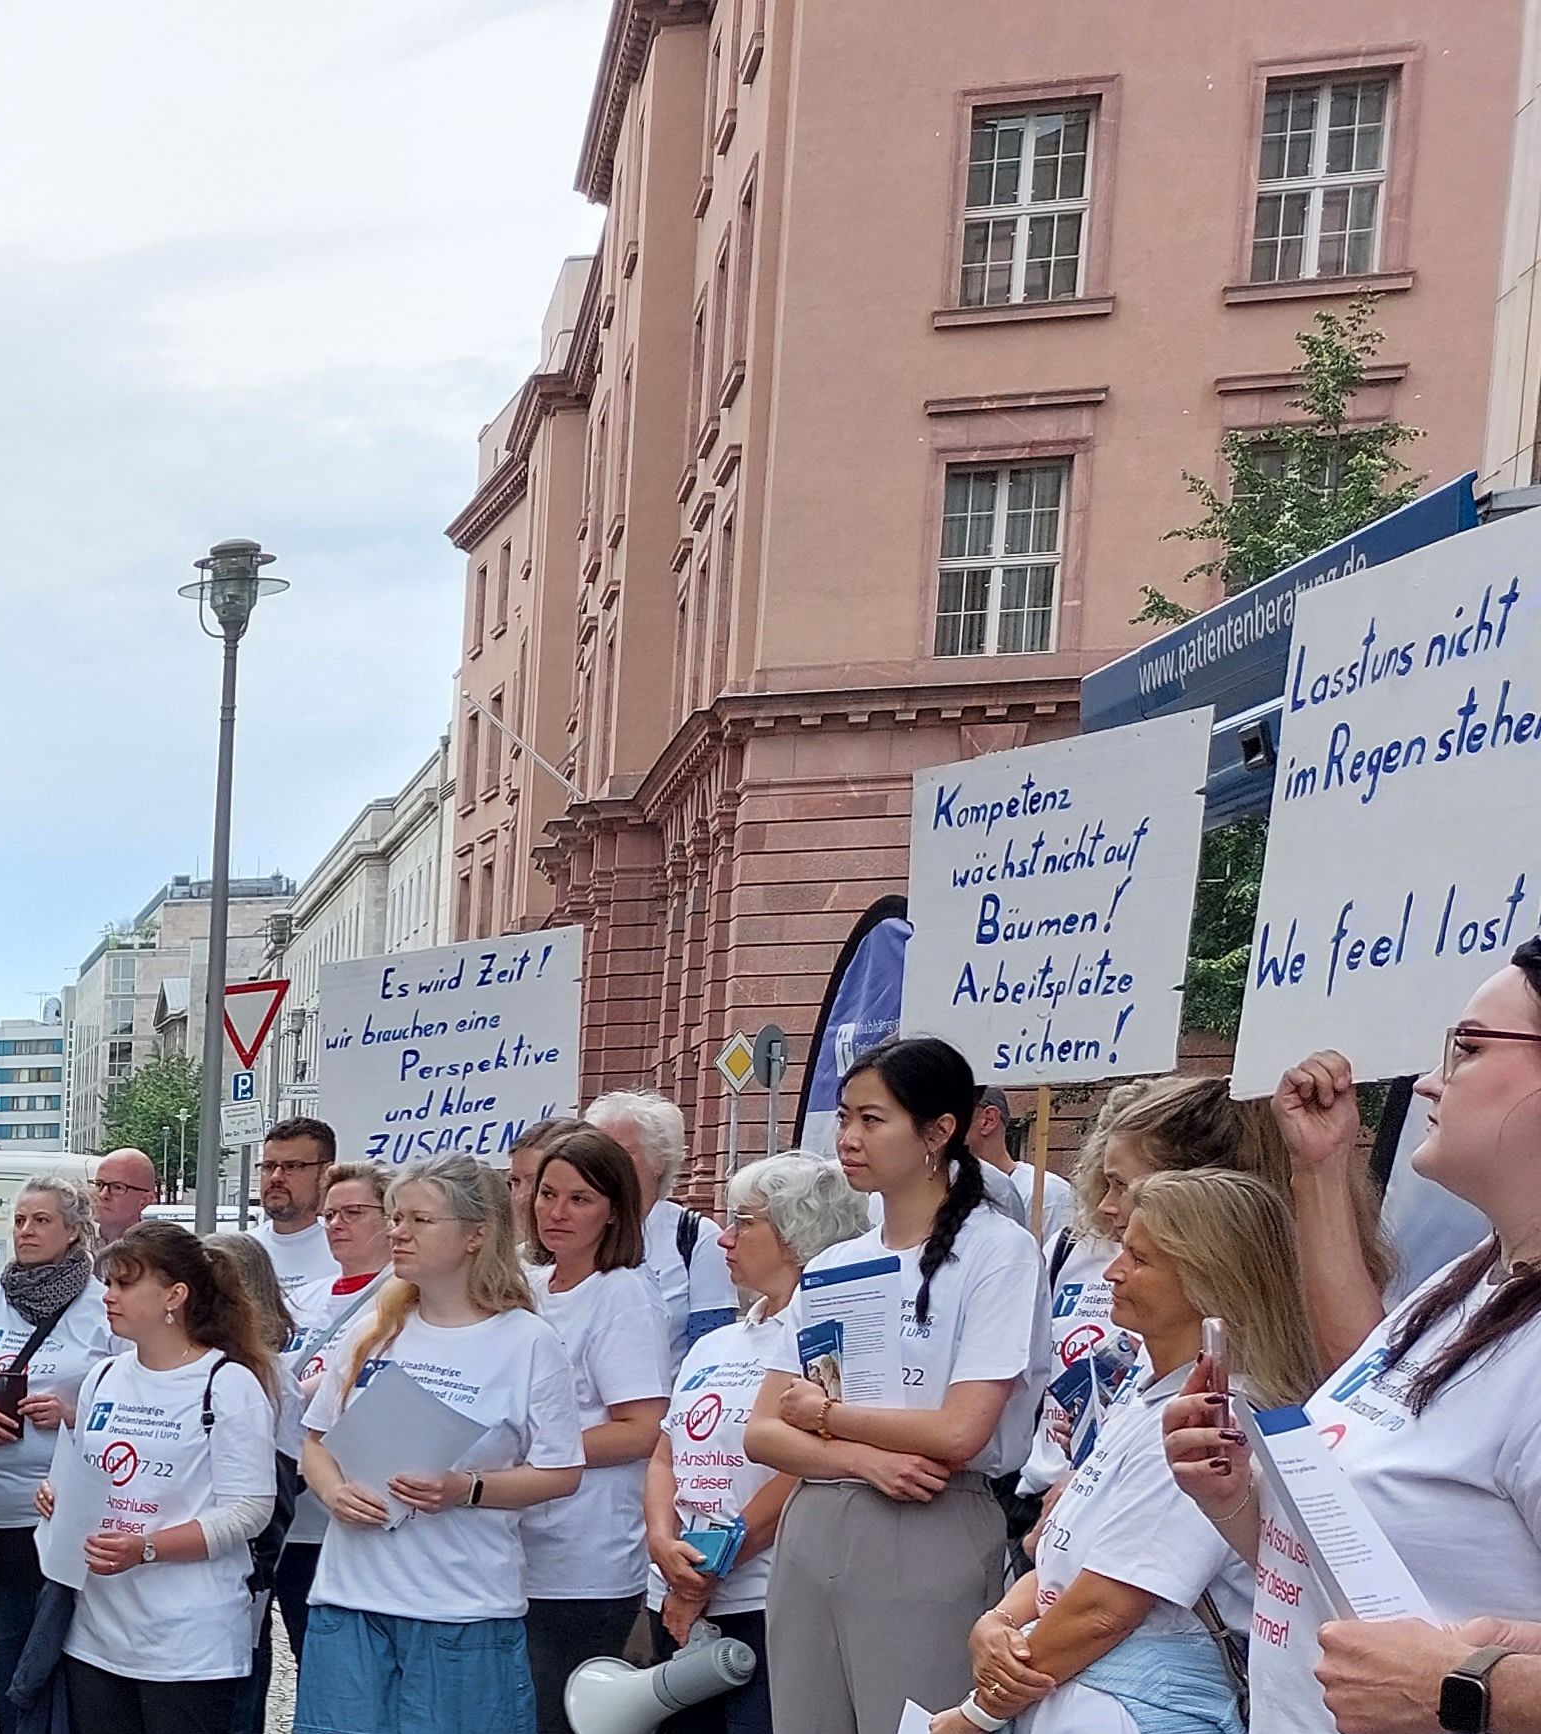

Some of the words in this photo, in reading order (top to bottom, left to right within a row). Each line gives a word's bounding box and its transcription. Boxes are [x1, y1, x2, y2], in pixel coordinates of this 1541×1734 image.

[1138, 544, 1367, 695] www.patientenberade
[1425, 575, 1520, 668] nicht
[1284, 757, 1317, 801] im
[1323, 722, 1427, 804] Regen
[933, 772, 1072, 836] Kompetenz
[952, 831, 1045, 888] wächst
[1042, 819, 1105, 874] nicht
[1103, 816, 1150, 871] auf
[975, 875, 1132, 945] Bäumen!
[1256, 917, 1306, 990] We
[1327, 891, 1414, 997] feel
[381, 967, 410, 1000] Es
[418, 958, 464, 994] wird
[952, 949, 1133, 1009] Arbeitsplätze
[325, 1027, 353, 1050] wir
[361, 1009, 447, 1046] brauchen
[455, 1010, 502, 1033] eine
[993, 1003, 1134, 1070] sichern!
[400, 1034, 560, 1082] Perspektive
[384, 1090, 434, 1122] und
[440, 1085, 497, 1116] klare
[365, 1118, 526, 1164] ZUSAGEN
[40, 1363, 57, 1375] 22
[400, 1360, 462, 1378] Unabhängige
[901, 1366, 925, 1386] 22
[153, 1462, 175, 1478] 22
[680, 1450, 745, 1468] Anschluss
[690, 1474, 733, 1490] dieser
[1267, 1567, 1303, 1607] dieser
